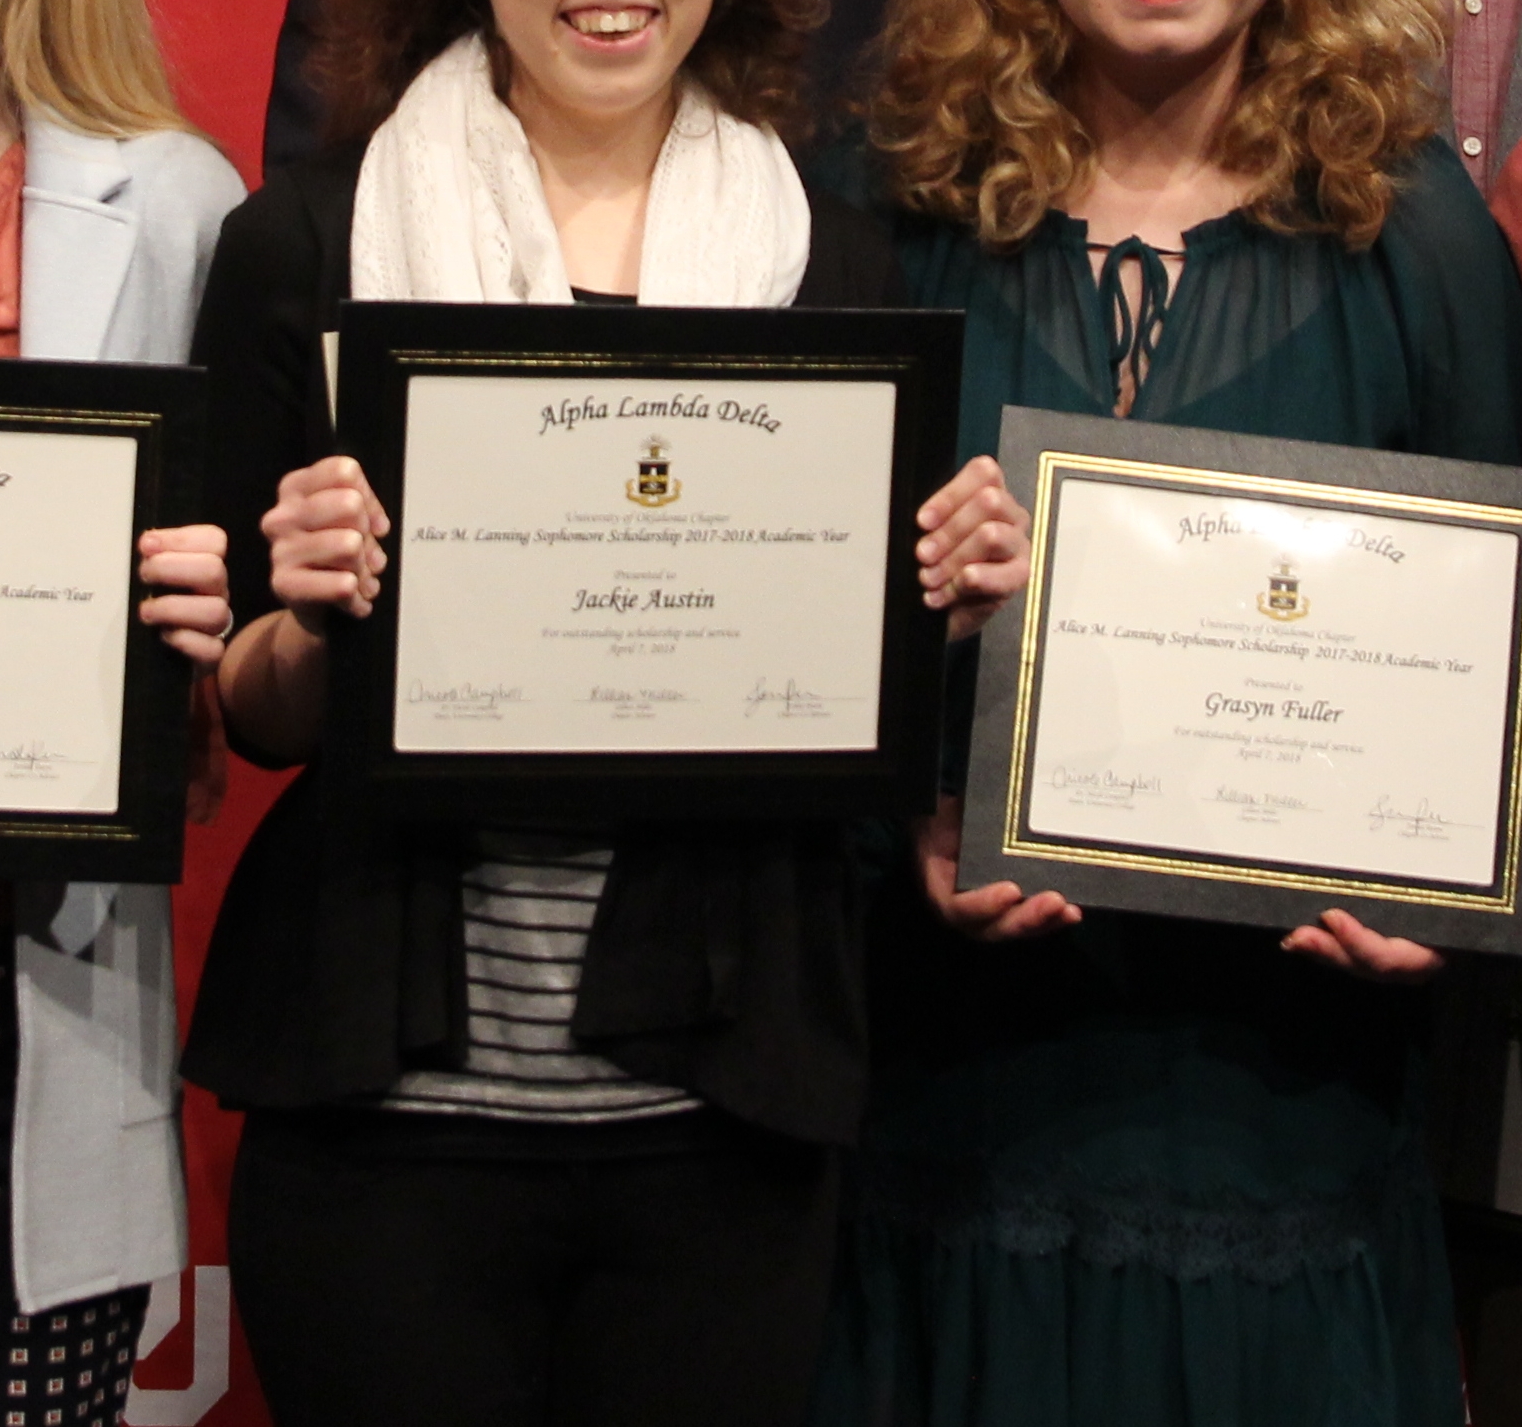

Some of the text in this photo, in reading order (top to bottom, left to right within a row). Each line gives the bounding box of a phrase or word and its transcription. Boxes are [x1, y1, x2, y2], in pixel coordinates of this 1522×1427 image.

[540, 393, 782, 435] Alpha Lambda Delta
[411, 526, 447, 541] Alice
[475, 527, 531, 545] Lanning
[534, 528, 604, 545] Sophomore
[607, 528, 681, 546] Scholarship
[685, 529, 753, 542] 2017-2018
[754, 528, 816, 543] Academic
[821, 530, 850, 542] Year
[1178, 512, 1241, 543] Alpha
[1347, 528, 1405, 563] Delta
[65, 588, 94, 600] Year
[572, 585, 715, 613] Jackie Austin
[1054, 620, 1086, 634] Alice
[1113, 626, 1166, 644] Lanning
[1168, 630, 1236, 649] Sophomore
[1238, 639, 1310, 659] Scholarship
[1315, 646, 1381, 664] 2017-2018
[1382, 652, 1441, 670] Academic
[1444, 659, 1473, 673] Year
[1205, 691, 1344, 722] Grasyn Fuller
